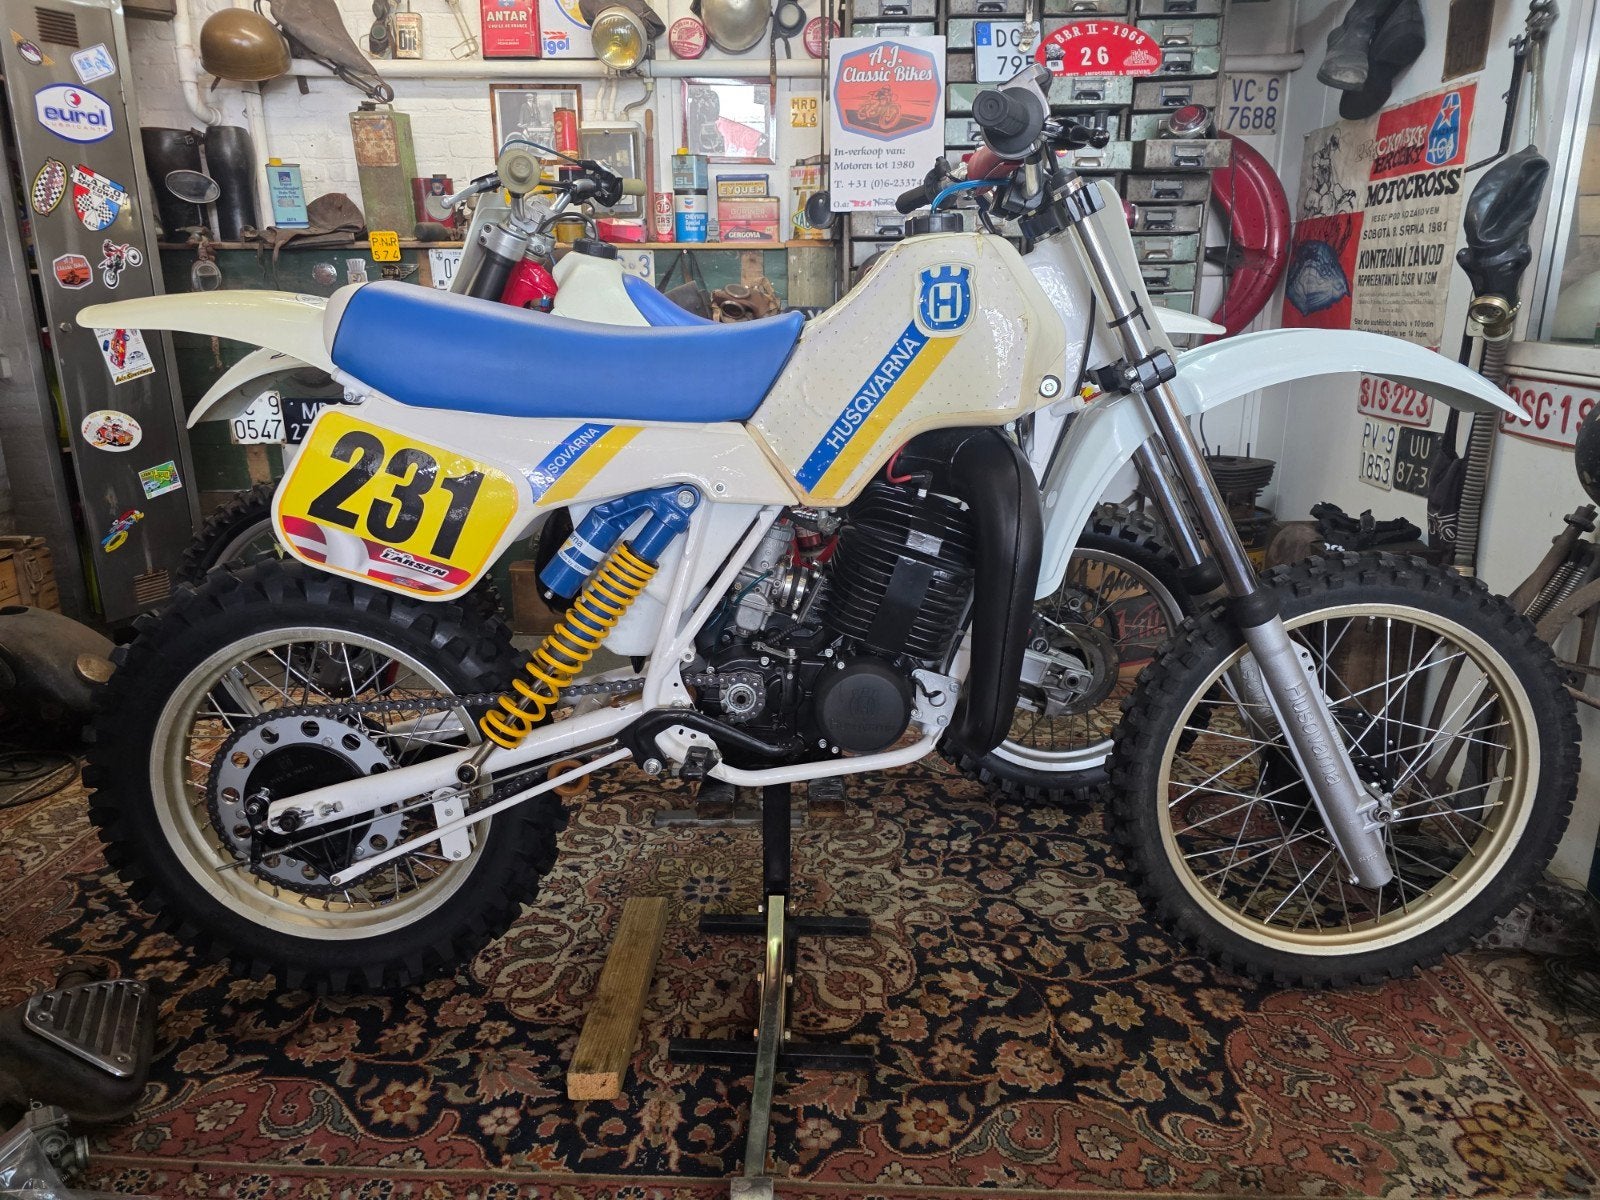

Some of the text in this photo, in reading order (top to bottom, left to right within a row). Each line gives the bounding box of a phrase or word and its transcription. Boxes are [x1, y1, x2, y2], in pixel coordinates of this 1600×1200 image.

[486, 10, 527, 22] ANTAR
[1112, 25, 1146, 45] 1968
[543, 38, 570, 55] igol
[869, 45, 902, 67] A.J.
[1080, 46, 1109, 66] 26
[842, 65, 933, 83] Classic Bikes
[44, 105, 106, 126] eurol
[791, 112, 817, 124] 716
[1227, 106, 1277, 130] 7688
[834, 146, 906, 159] In-verkoop van:
[834, 160, 915, 170] Motoren tot 1980
[674, 176, 693, 185] SL
[720, 186, 764, 195] EYQUEM
[834, 180, 844, 188] T.
[848, 180, 867, 188] +31
[1364, 167, 1462, 208] MOTOCROSS
[1362, 227, 1390, 240] SOBOTA
[374, 250, 399, 260] 574
[826, 336, 921, 450] HUSQVARNA
[234, 419, 282, 440] 0547
[1409, 434, 1431, 460] UU
[532, 427, 600, 490] SQVARNA
[1361, 451, 1391, 484] 1853
[307, 430, 486, 561] 231
[381, 552, 447, 578] LARSEN
